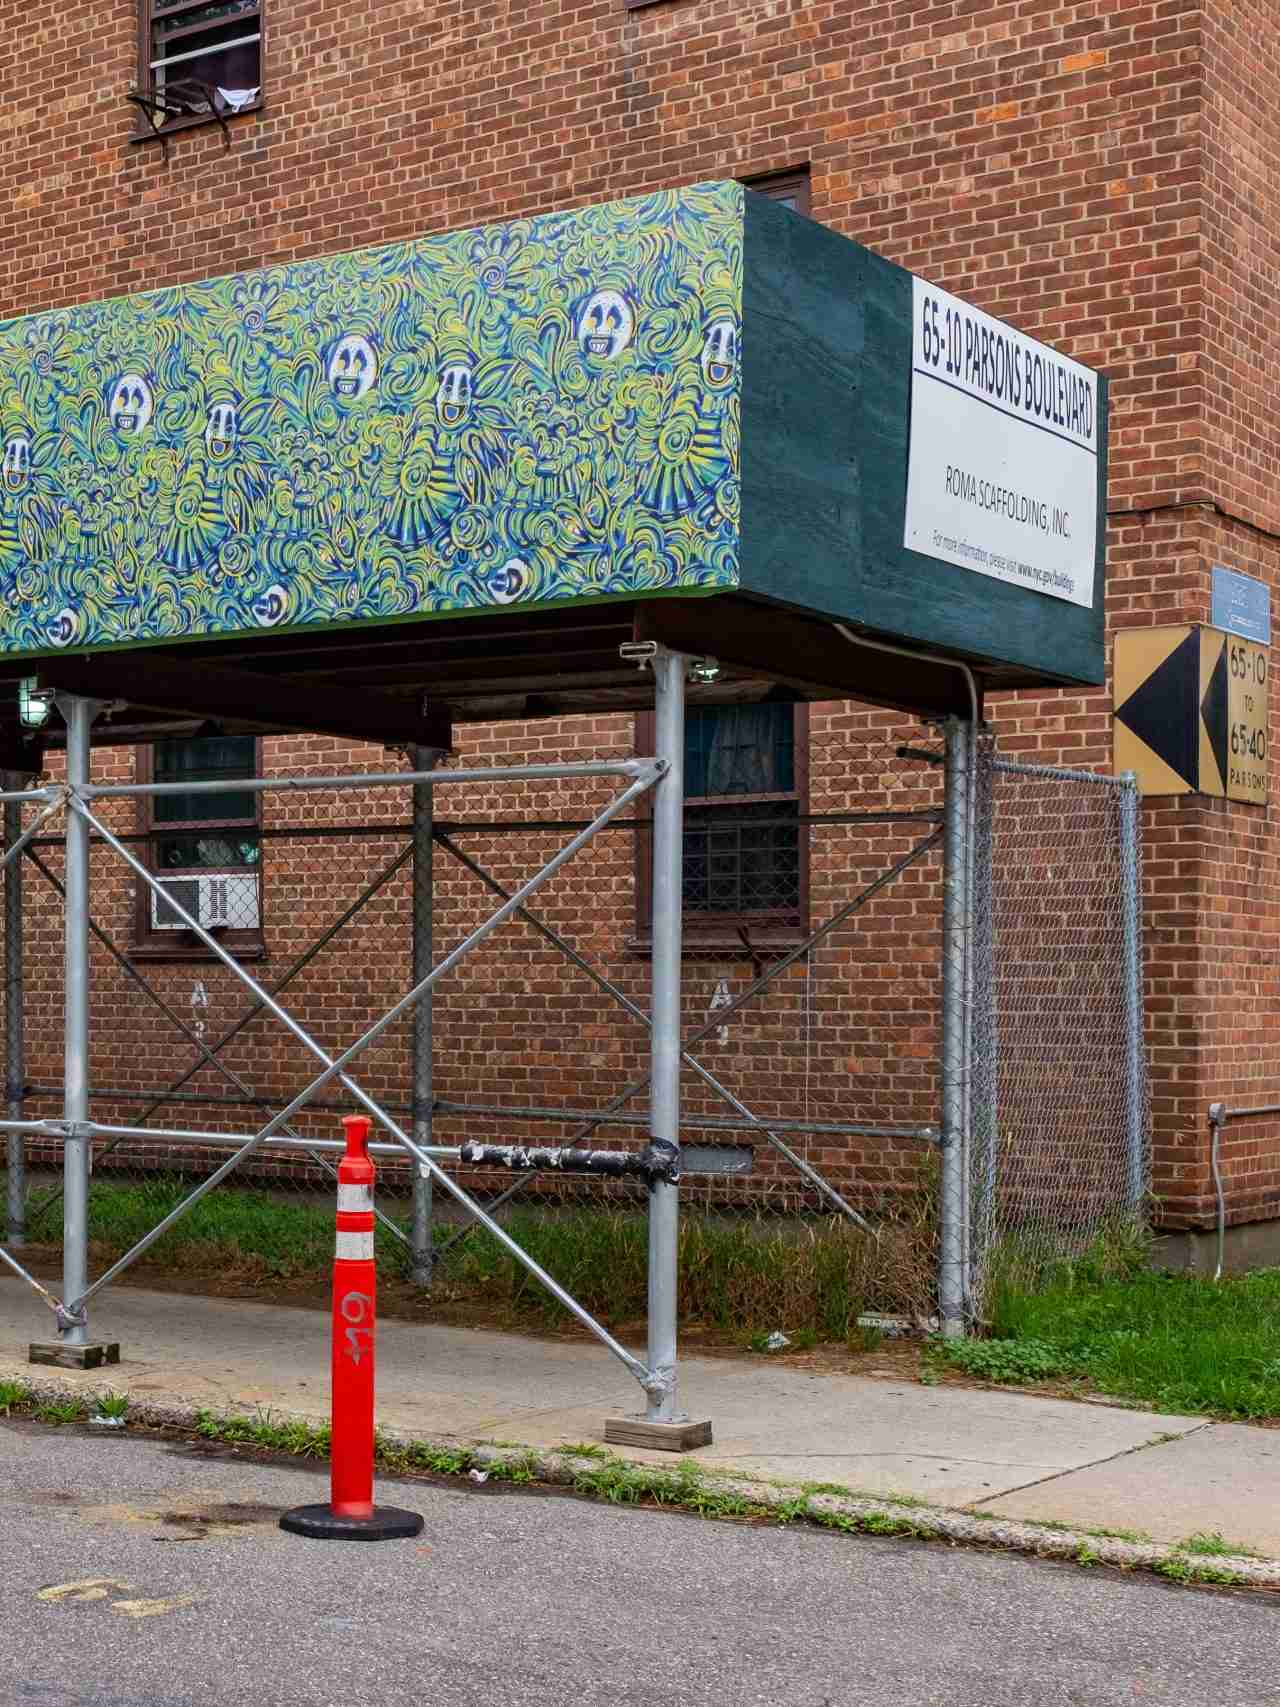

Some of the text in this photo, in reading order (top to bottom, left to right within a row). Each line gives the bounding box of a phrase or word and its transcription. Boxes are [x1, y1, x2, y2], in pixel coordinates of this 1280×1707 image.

[923, 296, 1093, 439] 65-10 PARSONS BOULEVARD
[945, 465, 1072, 539] ROMA SCAFFOLDING, INC.
[1243, 695, 1254, 713] TO
[1230, 768, 1266, 792] PARSONS
[192, 981, 208, 1009] A
[709, 980, 737, 1010] A
